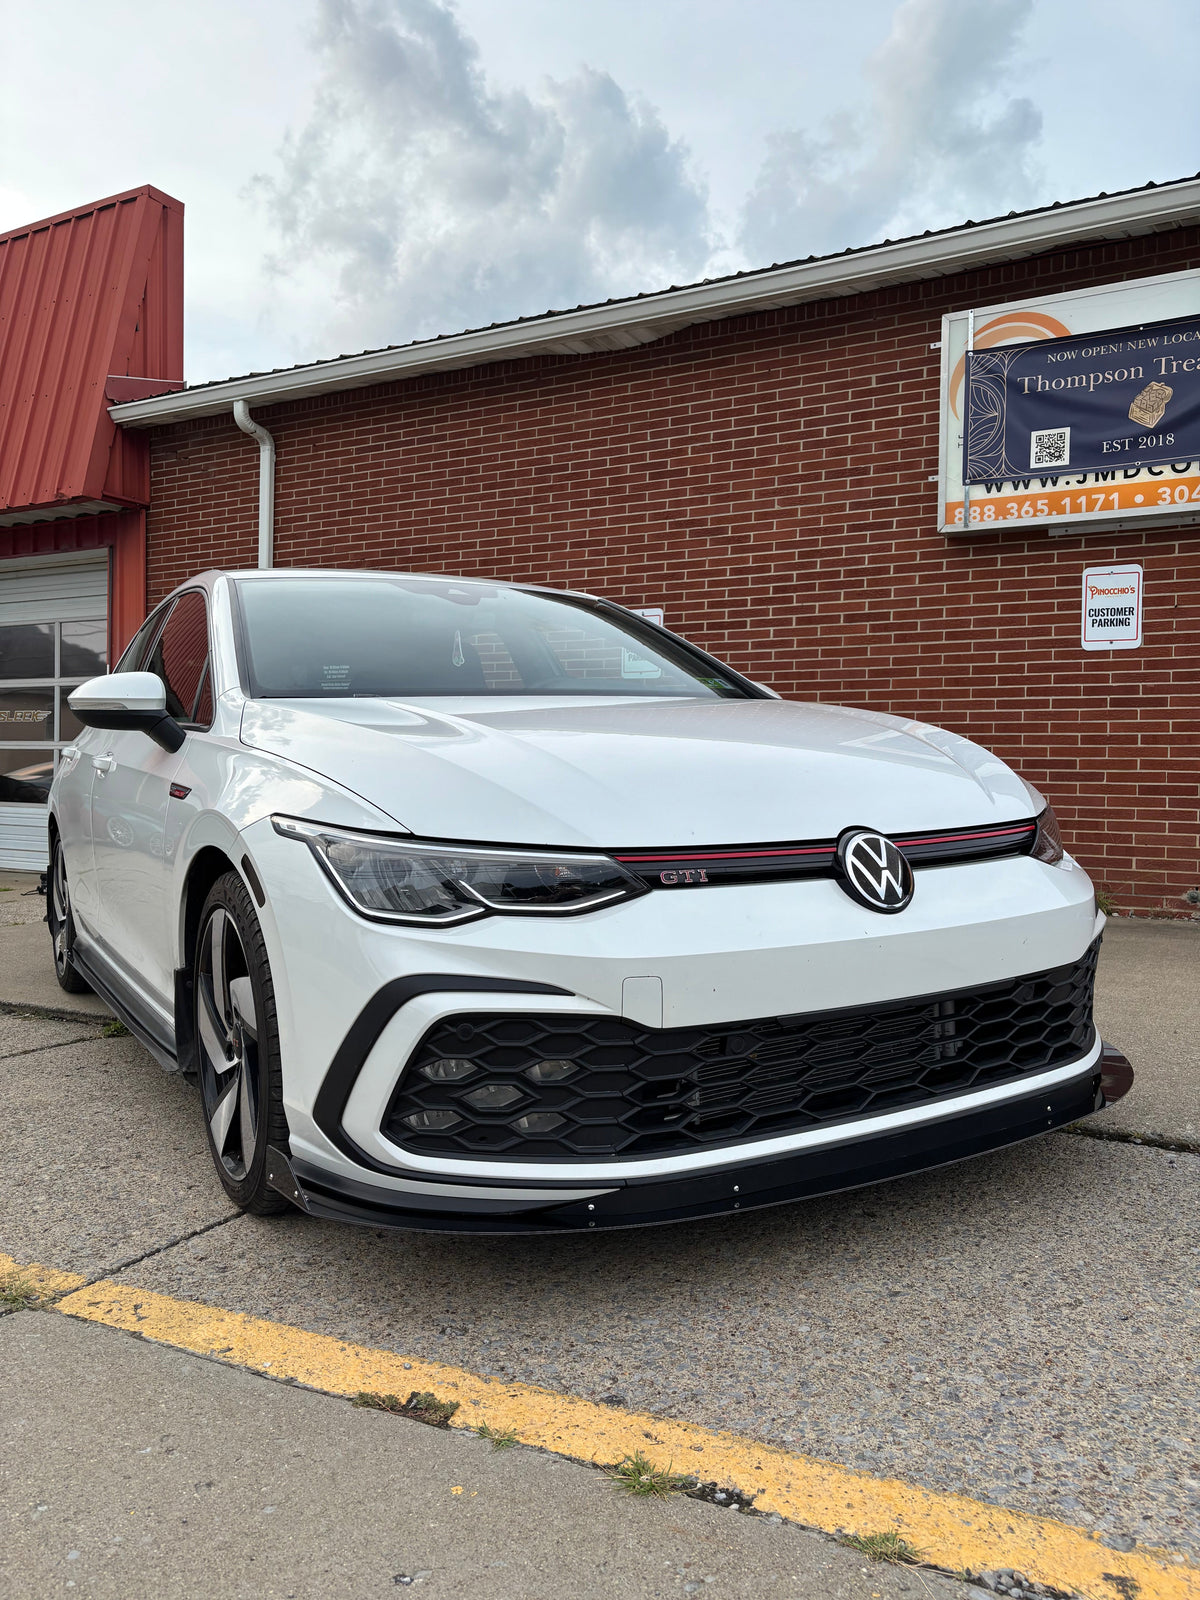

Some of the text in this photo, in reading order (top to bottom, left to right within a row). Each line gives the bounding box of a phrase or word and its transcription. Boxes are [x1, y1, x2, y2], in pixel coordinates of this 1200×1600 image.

[1047, 349, 1079, 363] NOW
[1081, 343, 1123, 358] OPEN!
[1127, 336, 1159, 351] NEW
[1017, 365, 1144, 395] Thompson
[1102, 432, 1175, 453] EST 2018
[954, 492, 1119, 524] 888.365.1171
[1088, 606, 1135, 618] CUSTOMER
[1091, 617, 1131, 628] PARKING
[660, 868, 709, 885] GTI
